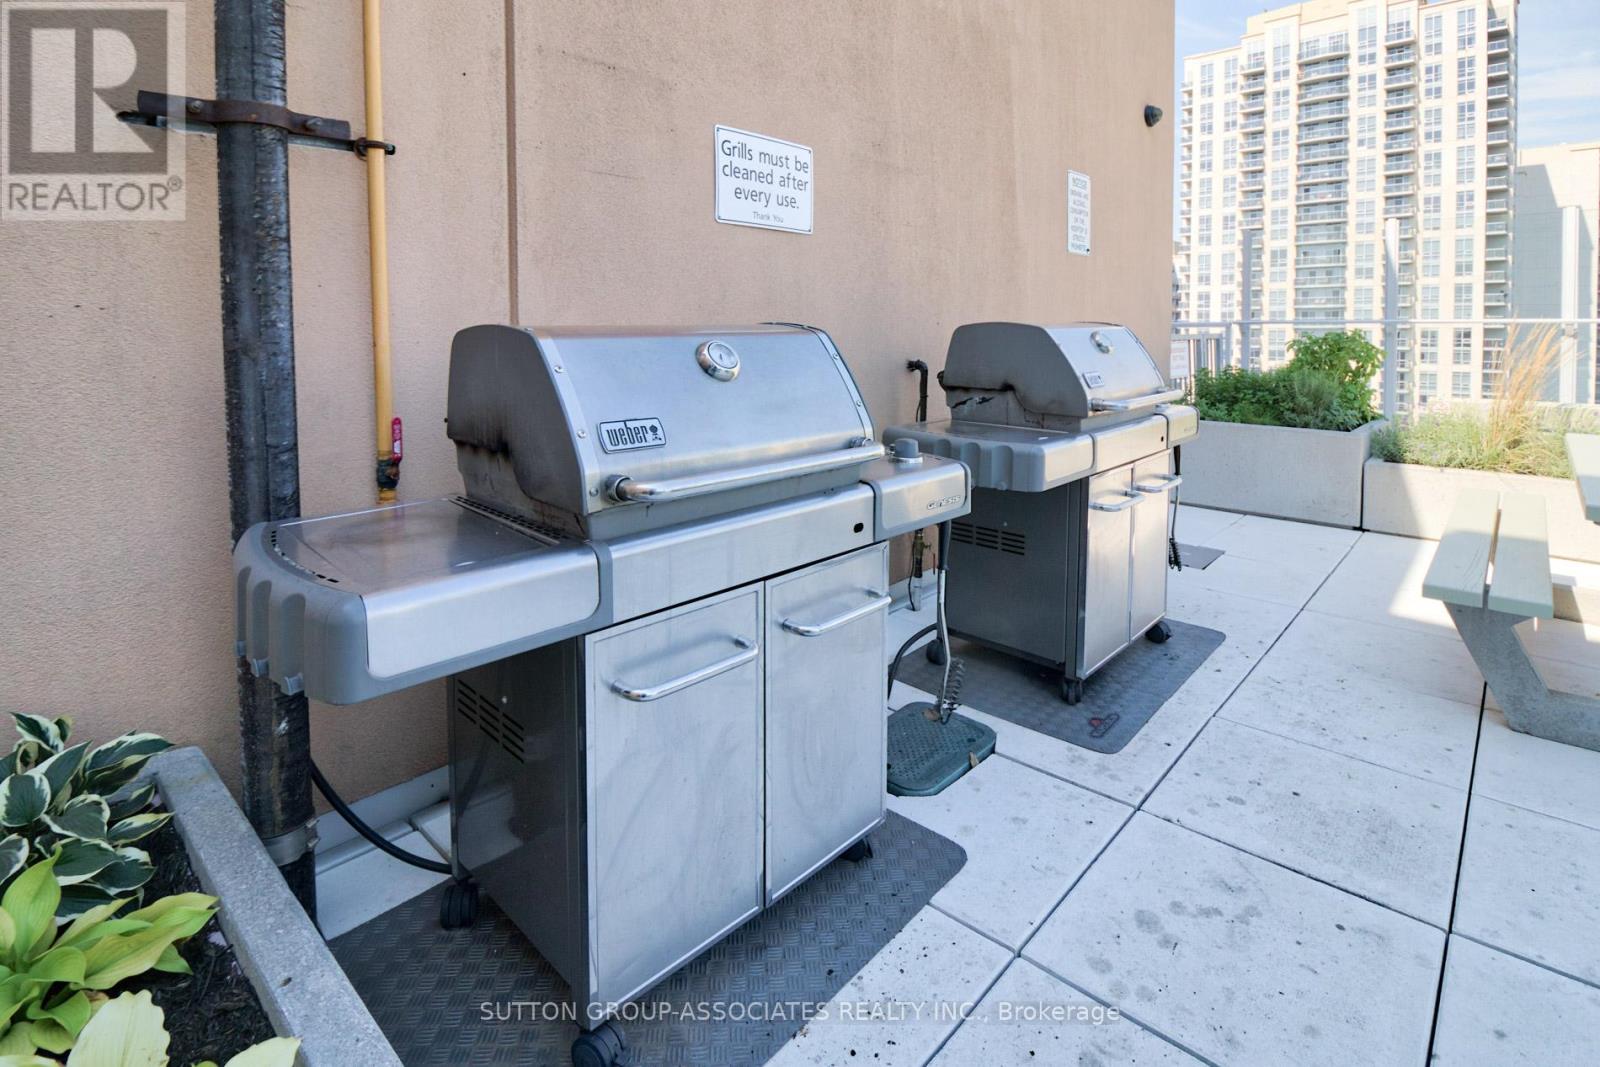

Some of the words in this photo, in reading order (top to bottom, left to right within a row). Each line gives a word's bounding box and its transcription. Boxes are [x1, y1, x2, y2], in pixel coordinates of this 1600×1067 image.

[721, 139, 753, 161] Grills
[759, 151, 790, 169] must
[795, 155, 809, 174] be
[722, 160, 774, 185] cleaned
[779, 173, 809, 192] after
[734, 186, 771, 207] every
[776, 194, 800, 209] use.
[753, 211, 771, 221] Thank
[773, 214, 785, 223] You
[606, 422, 649, 447] weber
